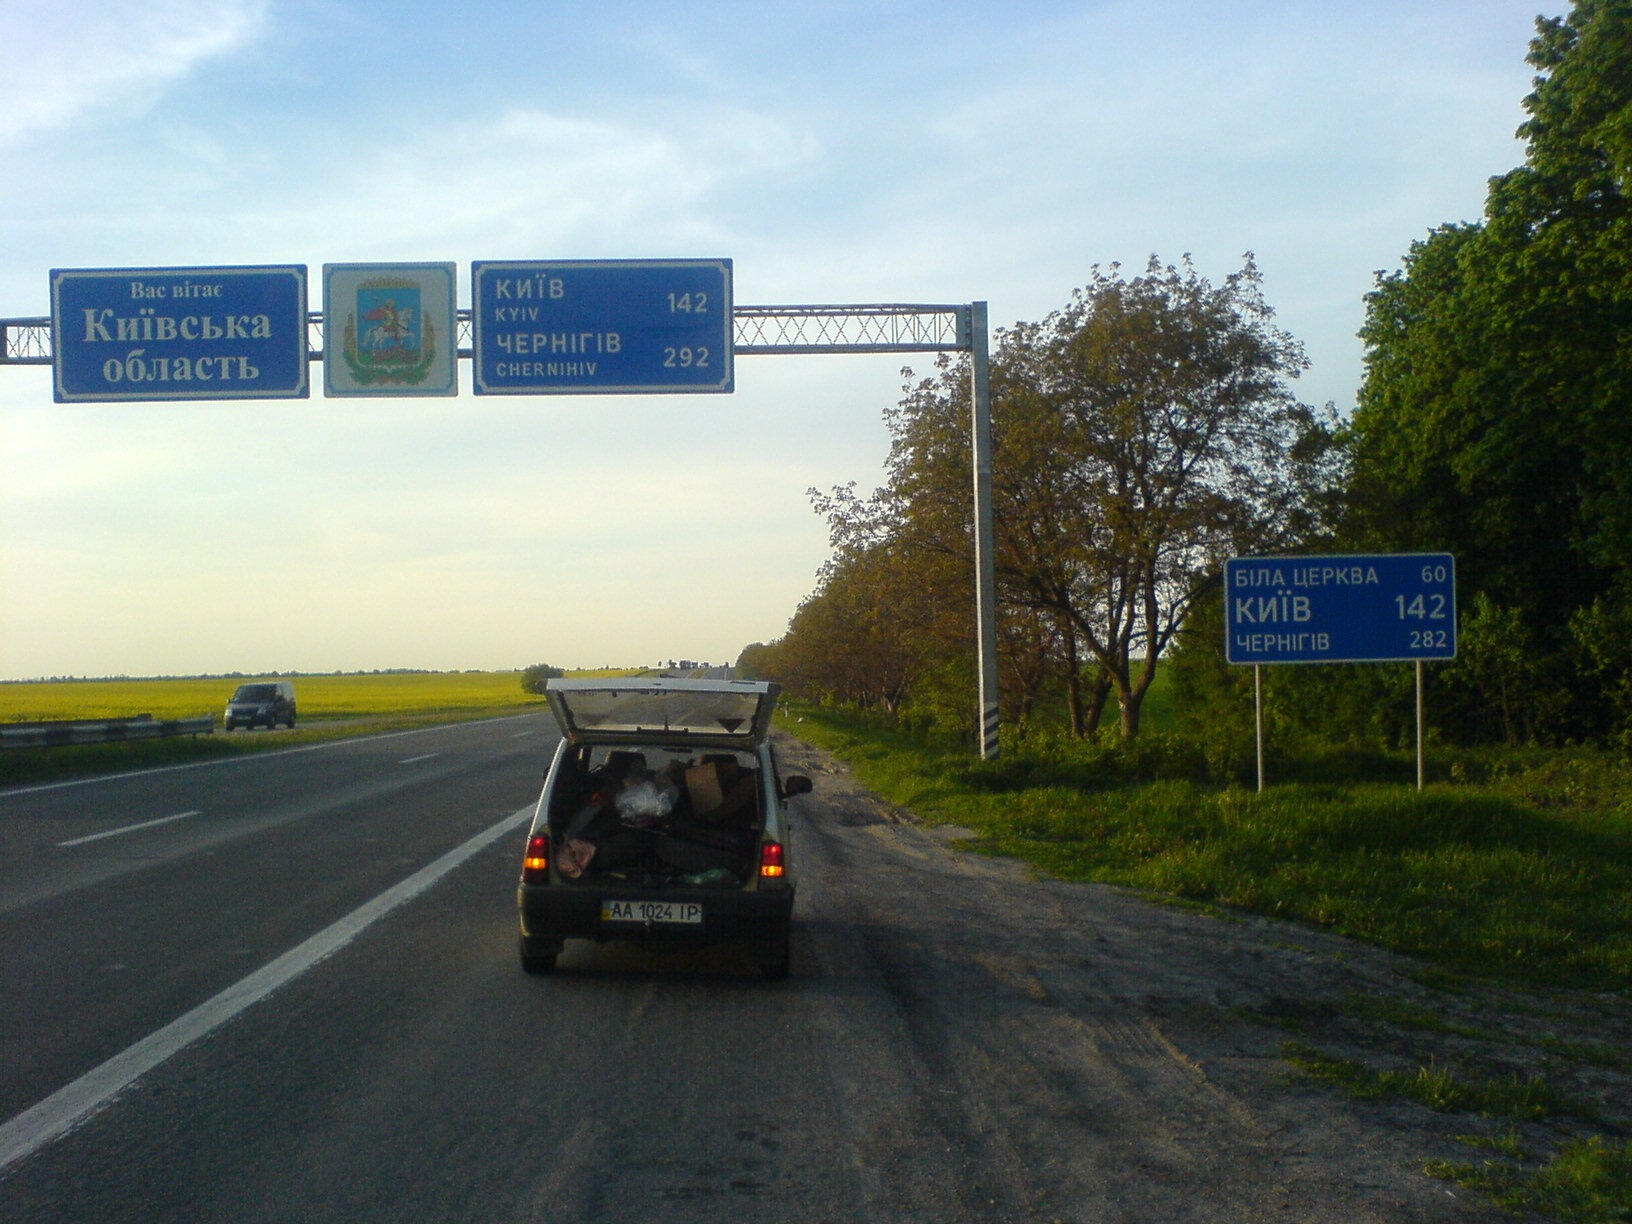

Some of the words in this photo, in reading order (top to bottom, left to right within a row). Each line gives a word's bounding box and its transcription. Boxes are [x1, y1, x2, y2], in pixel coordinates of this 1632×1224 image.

[131, 281, 166, 299] Вас
[173, 281, 223, 298] вітає
[496, 274, 564, 299] КИЇВ
[667, 293, 708, 313] 142
[82, 308, 272, 342] Київська
[495, 307, 539, 322] KYIV
[497, 333, 622, 354] ЧЕРНІГІВ
[103, 349, 260, 382] область
[663, 348, 709, 368] 292
[496, 362, 597, 377] CHERNIHIV
[1235, 569, 1286, 587] БІЛА
[1293, 567, 1379, 588] ЦЕРКВА
[1421, 566, 1447, 583] 60
[1235, 590, 1312, 624] КИЇВ
[1395, 594, 1446, 620] 142
[1237, 632, 1330, 652] ЧЕРНІГІВ
[1410, 631, 1447, 648] 282
[611, 903, 633, 918] AA
[639, 904, 673, 919] 1024
[680, 905, 699, 920] IP
